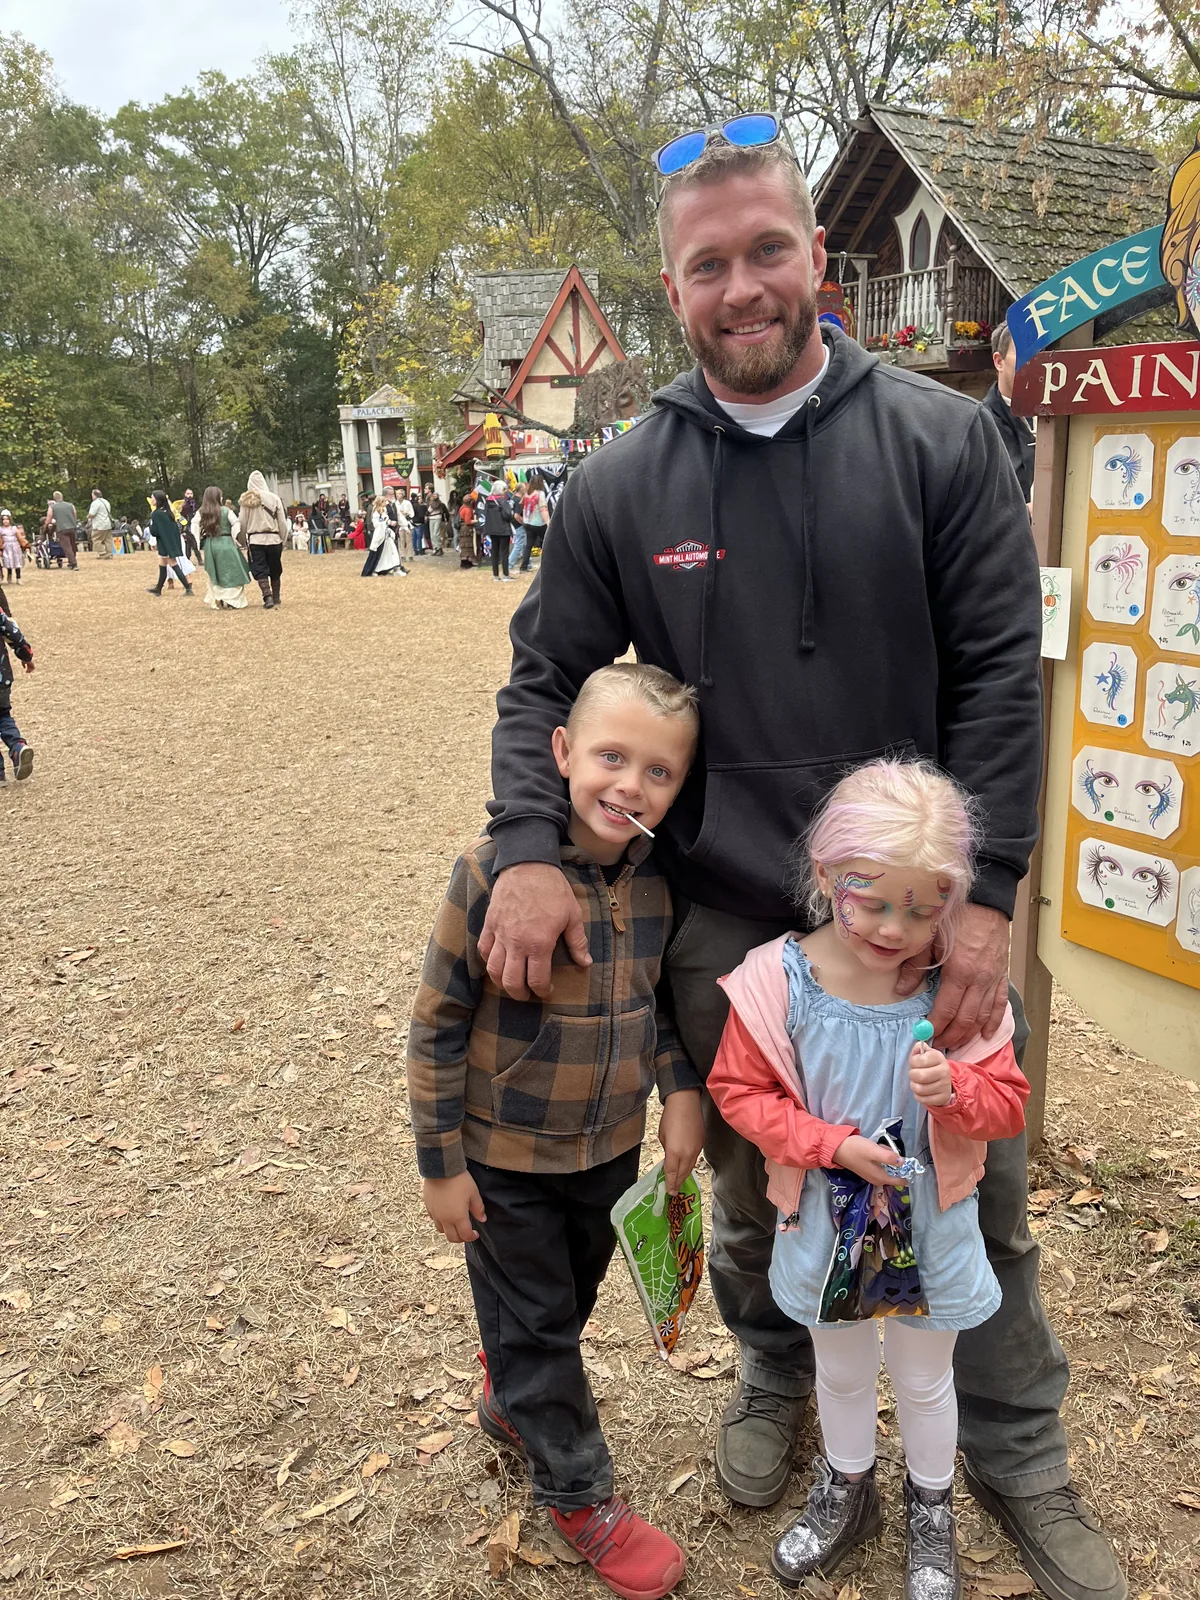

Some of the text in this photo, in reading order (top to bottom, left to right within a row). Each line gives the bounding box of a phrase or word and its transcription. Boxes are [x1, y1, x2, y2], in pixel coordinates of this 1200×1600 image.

[1022, 245, 1152, 340] FACE
[357, 407, 386, 416] PALACE
[659, 555, 673, 564] MINT
[673, 553, 684, 562] HILL
